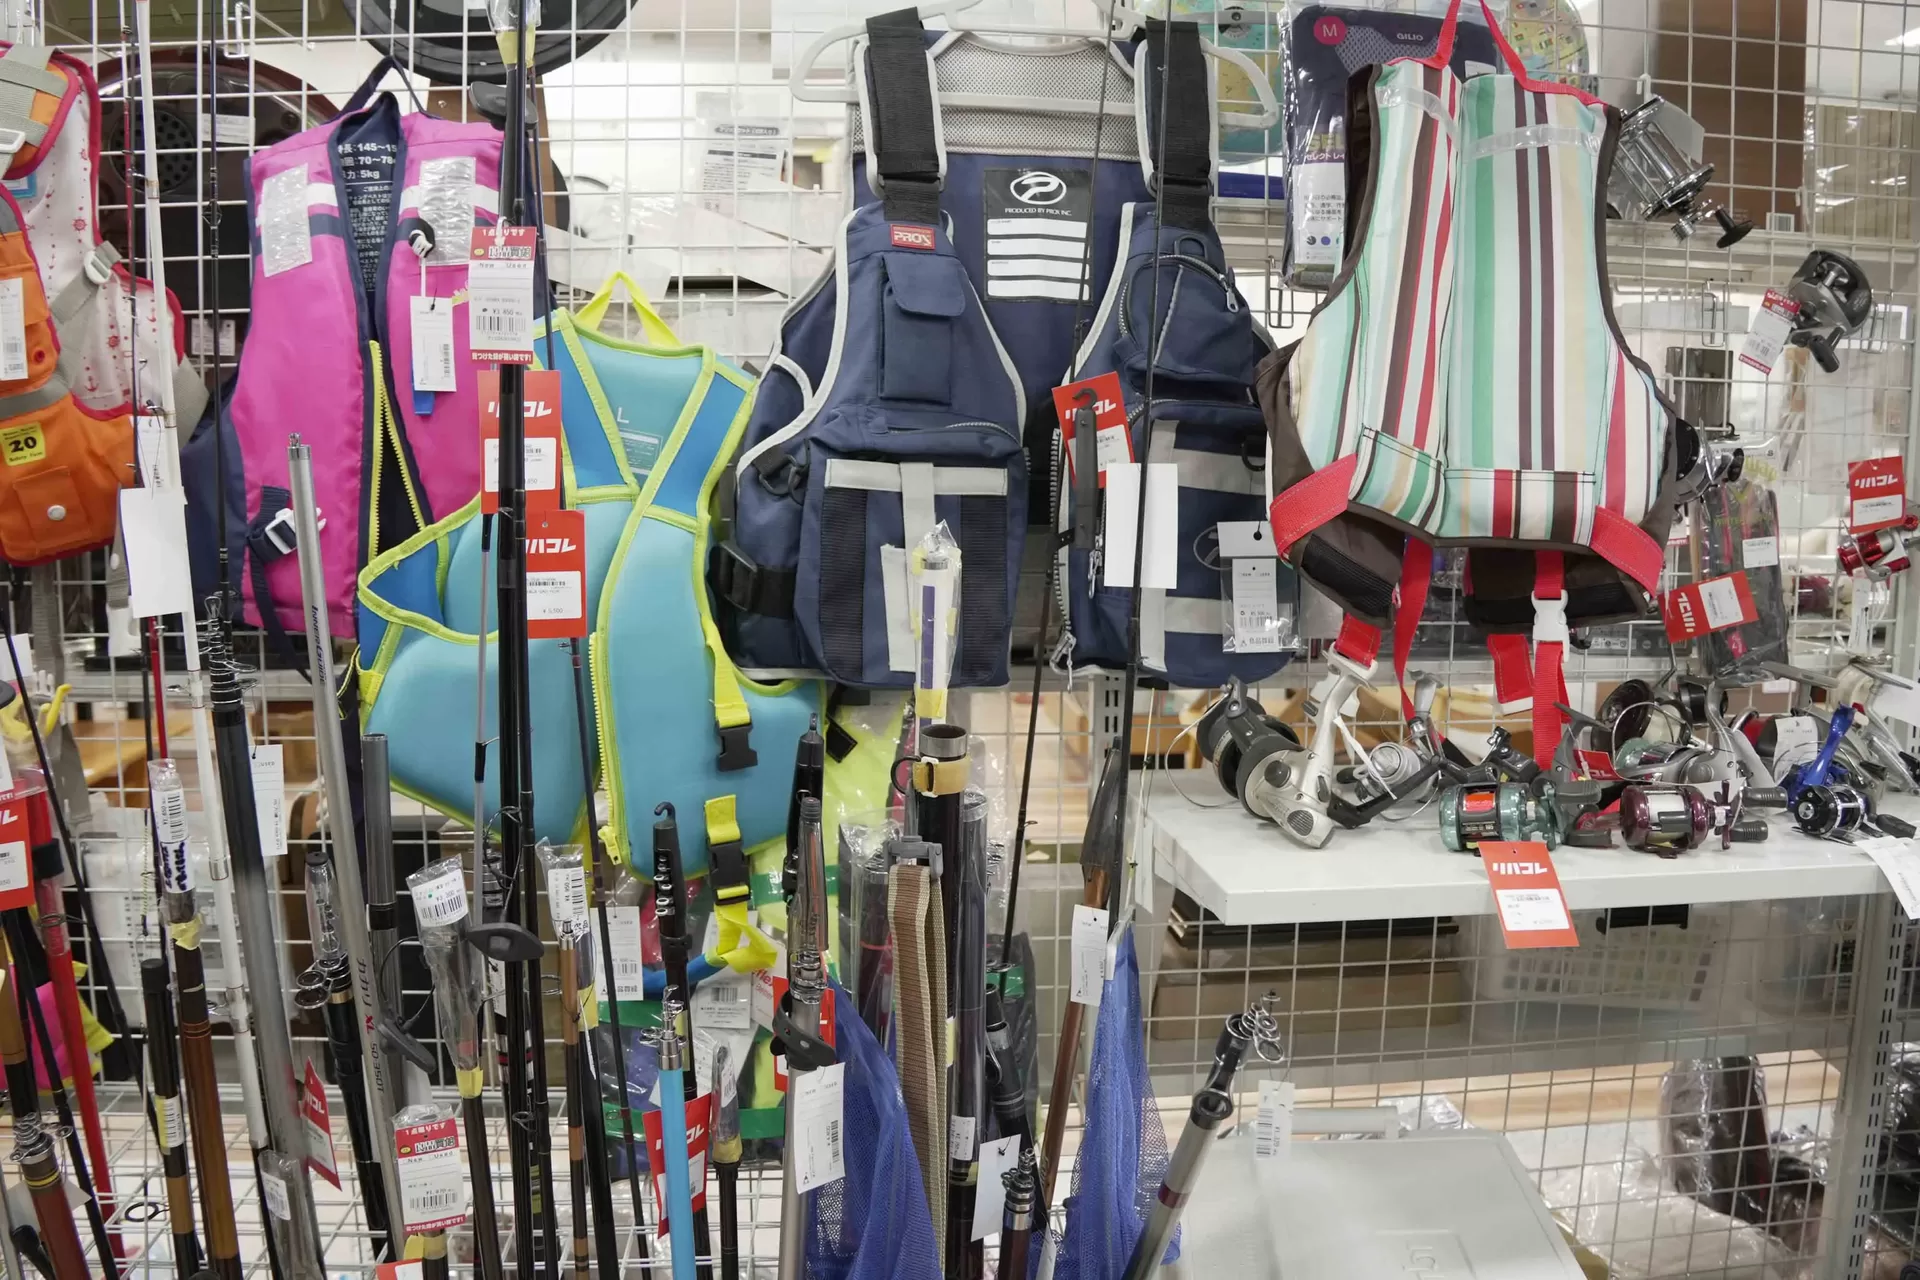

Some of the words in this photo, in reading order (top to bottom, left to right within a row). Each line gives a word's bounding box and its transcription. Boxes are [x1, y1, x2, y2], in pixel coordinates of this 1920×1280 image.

[1322, 24, 1338, 37] M
[482, 228, 526, 237] 1点りです
[893, 231, 933, 247] PROX
[617, 407, 630, 424] L
[8, 435, 37, 454] 20
